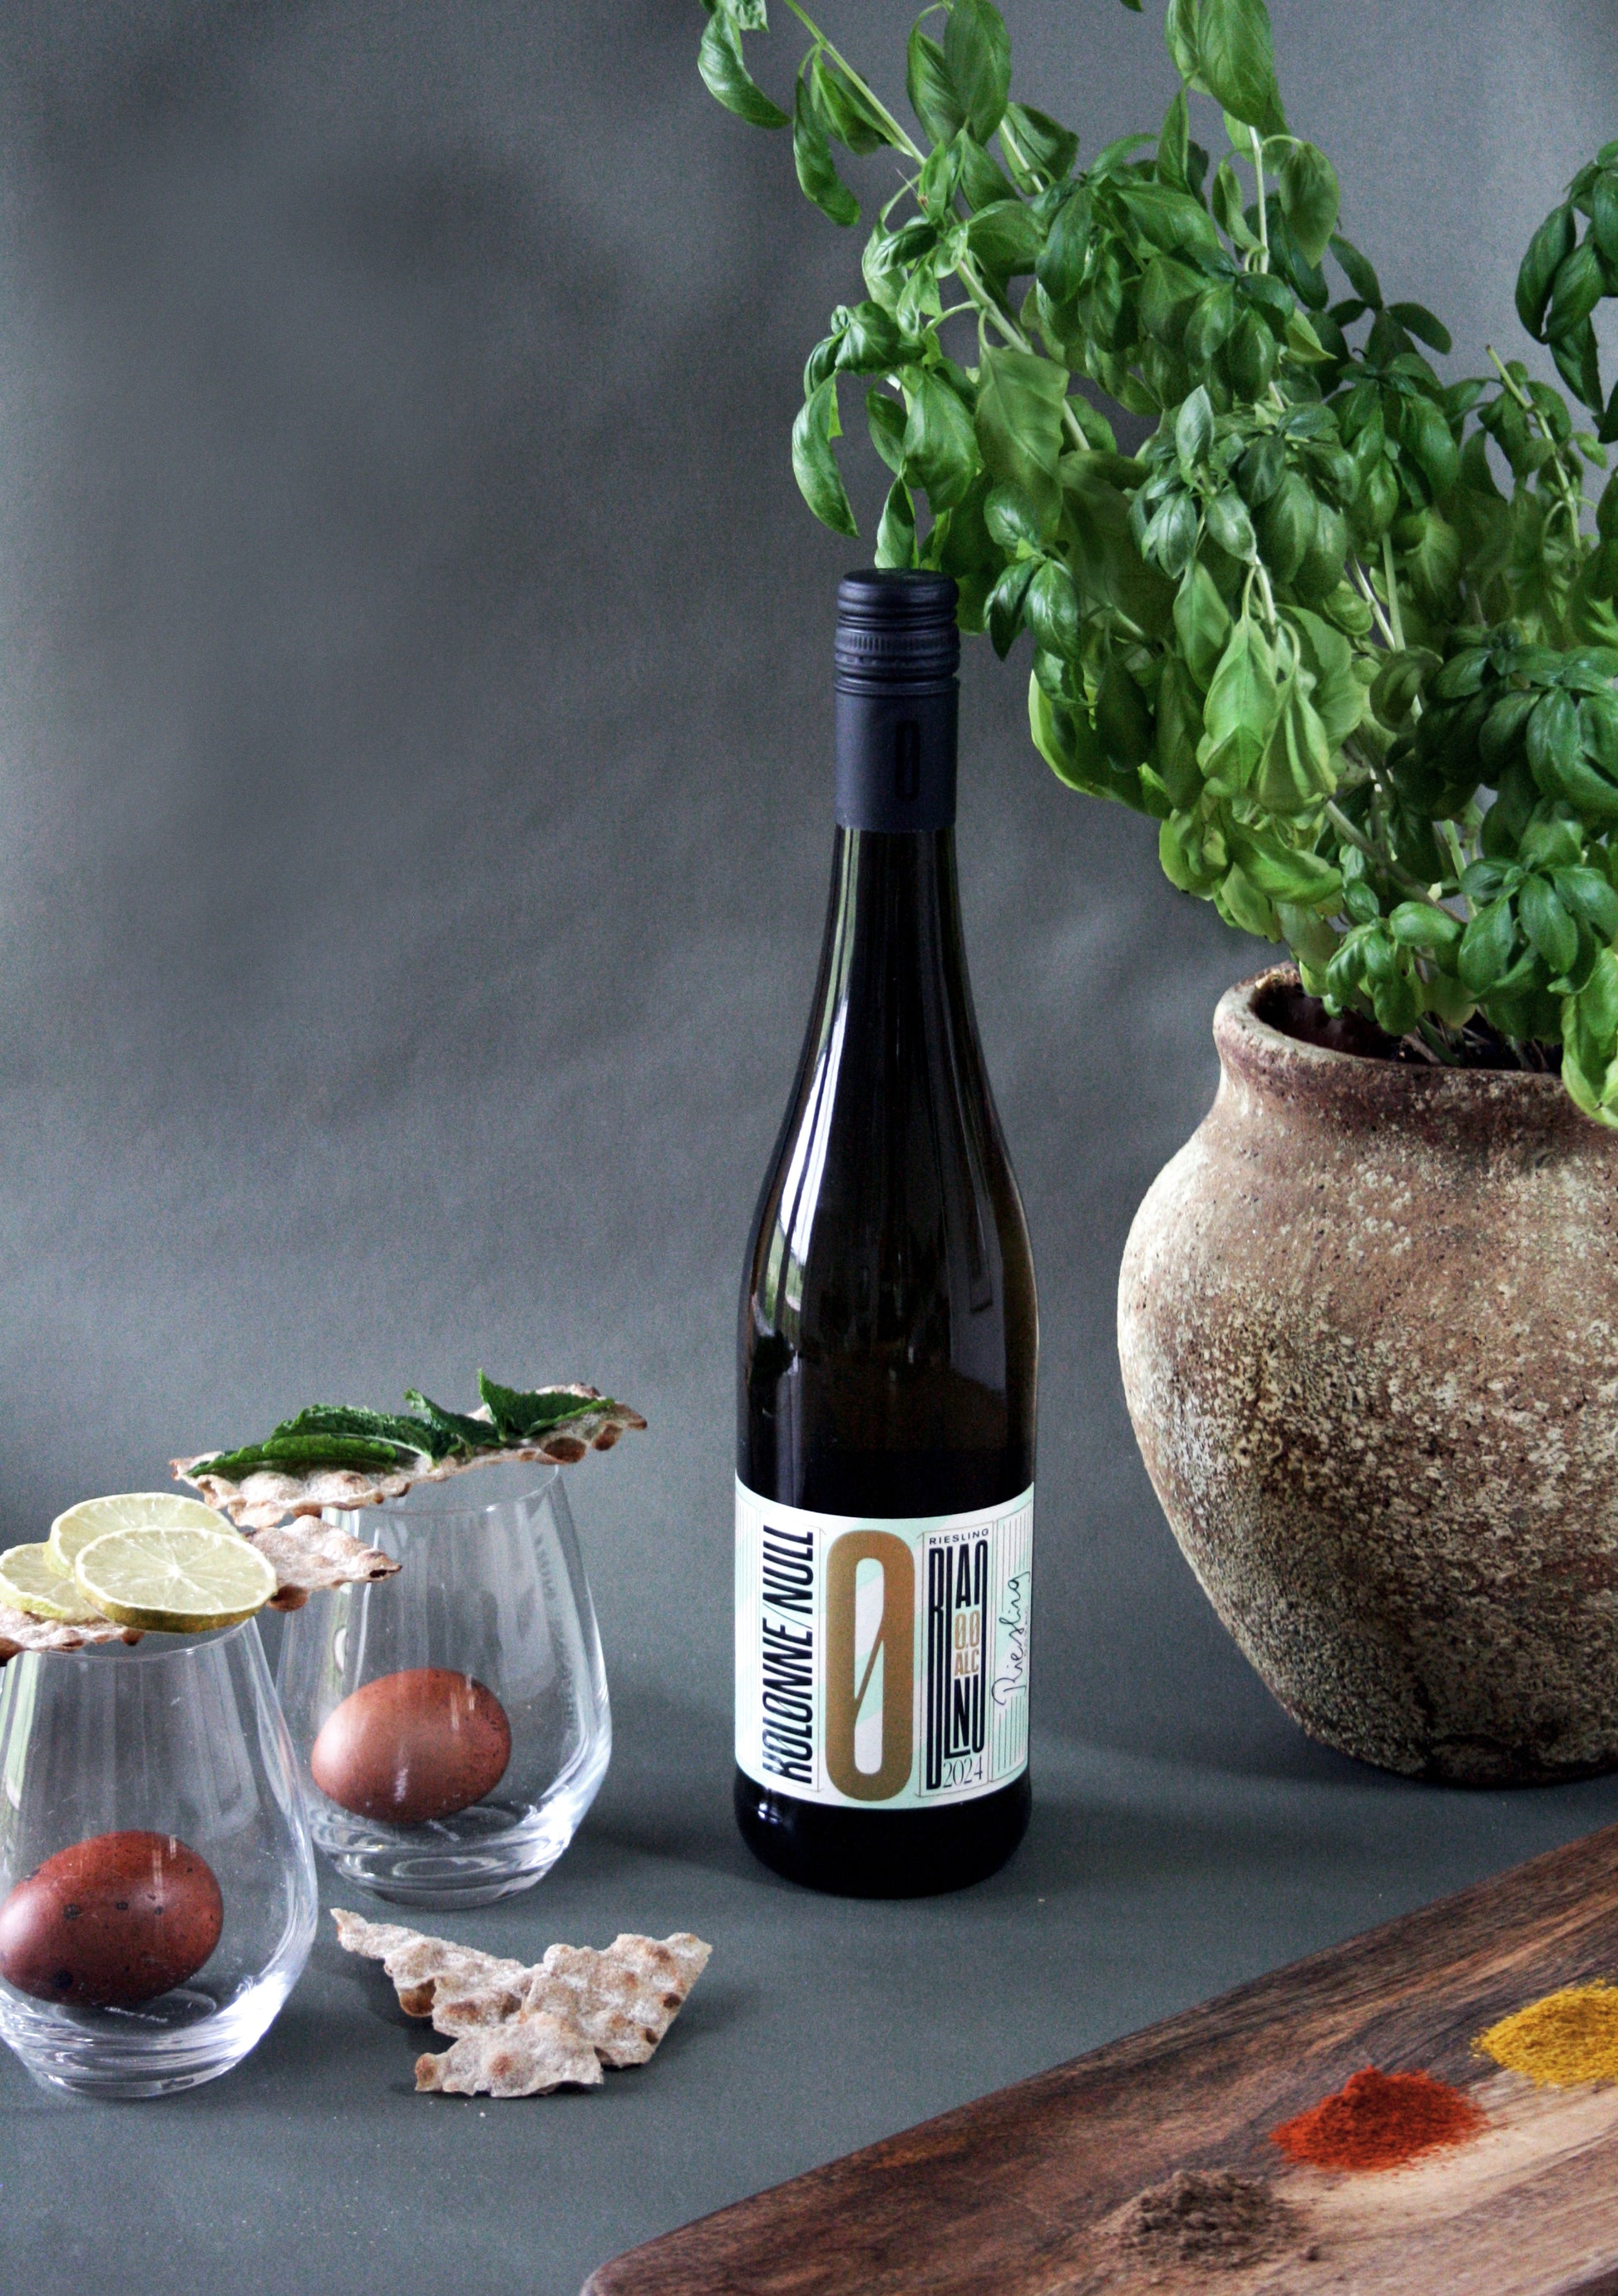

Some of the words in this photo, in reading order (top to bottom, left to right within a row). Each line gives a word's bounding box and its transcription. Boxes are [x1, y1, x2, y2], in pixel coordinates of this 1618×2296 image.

[930, 1528, 989, 1545] RIESLING
[955, 1610, 980, 1650] 0.0
[992, 1571, 1030, 1705] Riesling
[955, 1648, 979, 1676] ALC
[943, 1755, 983, 1787] 2024
